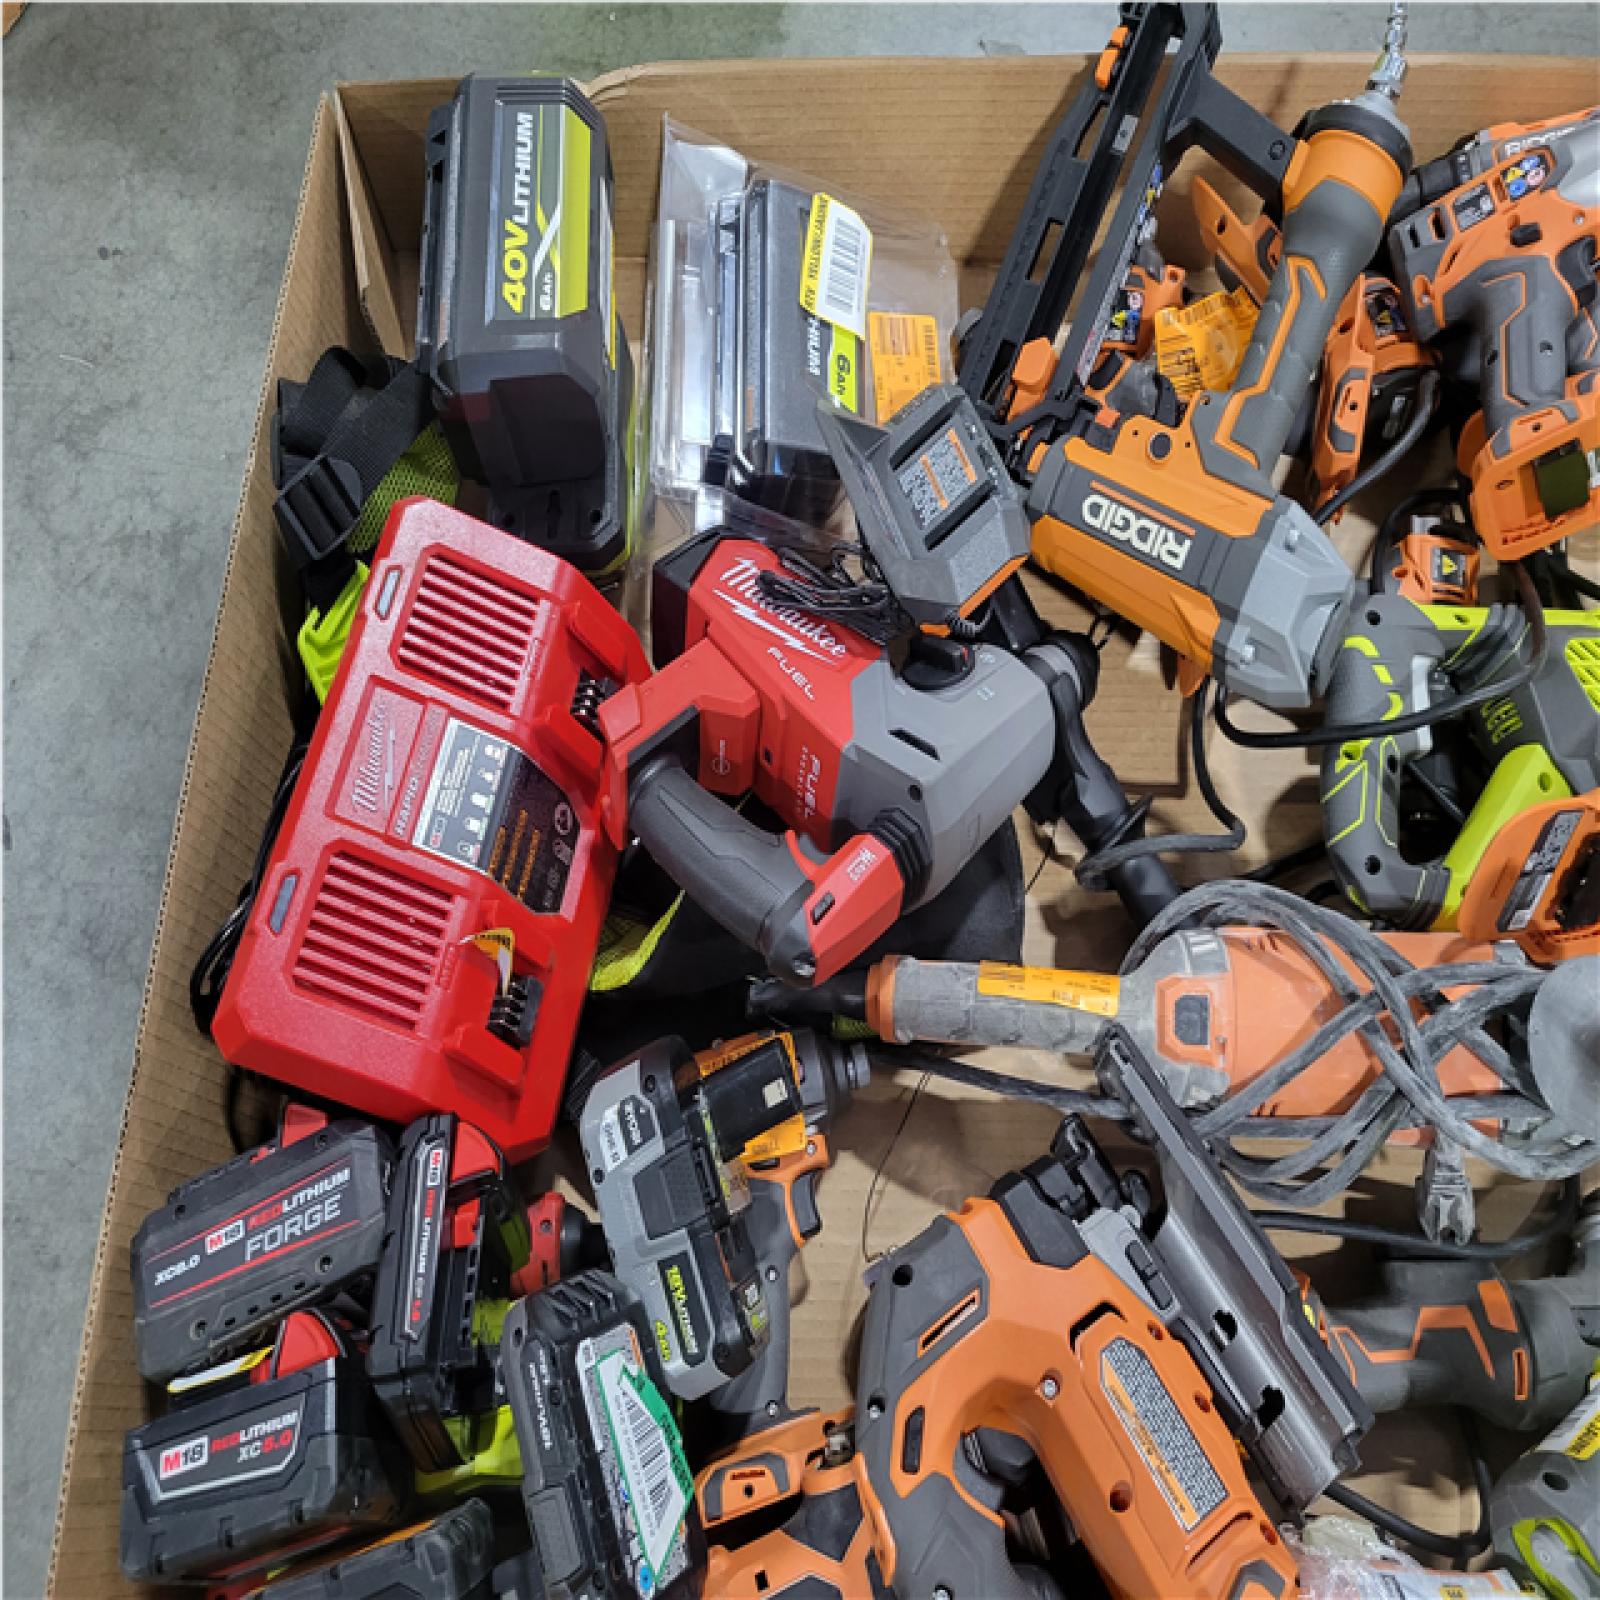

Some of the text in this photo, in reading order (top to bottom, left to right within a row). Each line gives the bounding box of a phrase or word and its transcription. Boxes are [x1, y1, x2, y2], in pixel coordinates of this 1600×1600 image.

[1082, 494, 1192, 571] RIDGID
[767, 646, 816, 700] FUEL
[244, 1194, 341, 1261] FORGE
[162, 1438, 206, 1474] M18
